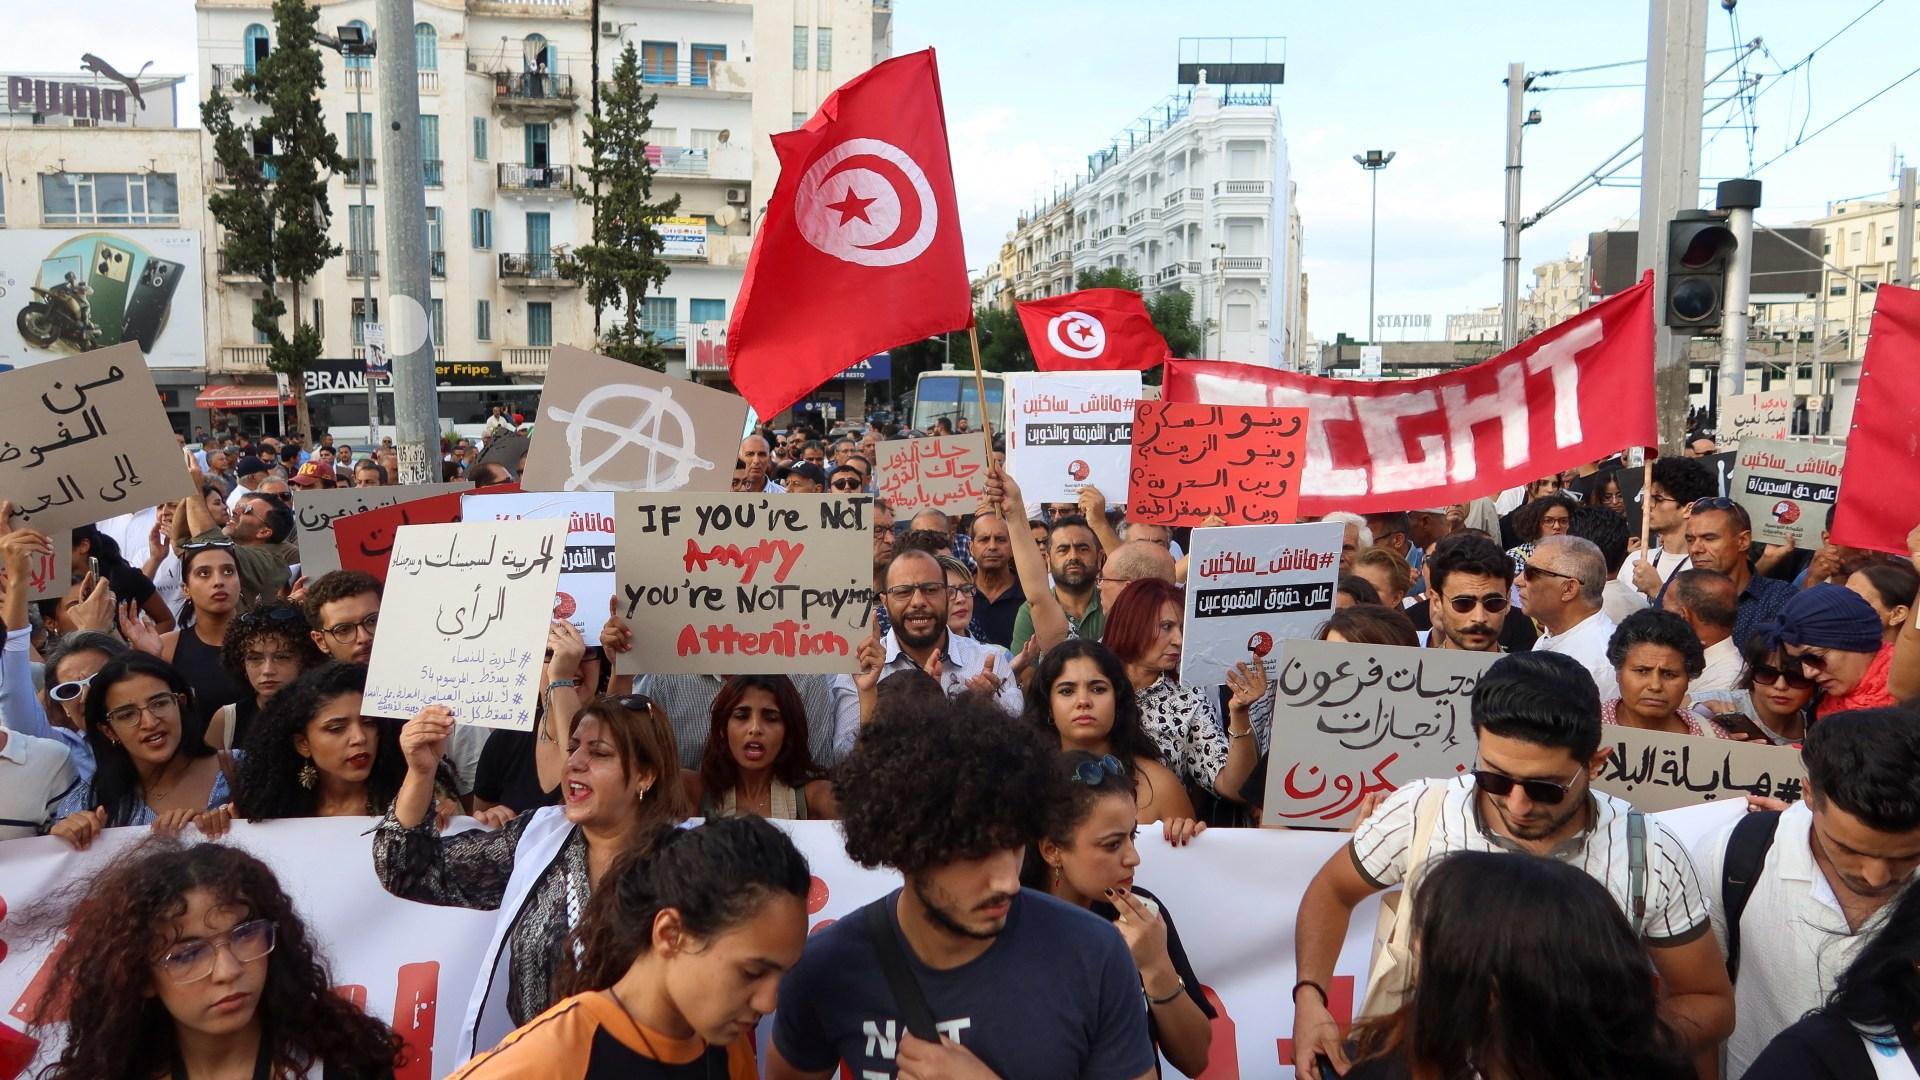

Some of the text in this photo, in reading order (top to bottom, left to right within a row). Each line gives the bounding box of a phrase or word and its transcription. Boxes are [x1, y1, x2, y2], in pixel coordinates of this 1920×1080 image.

[8, 76, 126, 122] PUMA
[1377, 314, 1432, 328] STATION
[41, 364, 125, 414] من
[454, 364, 490, 376] Fripe
[638, 504, 682, 537] IF
[1279, 656, 1384, 708] فرعون
[1316, 697, 1461, 752] إنجازات
